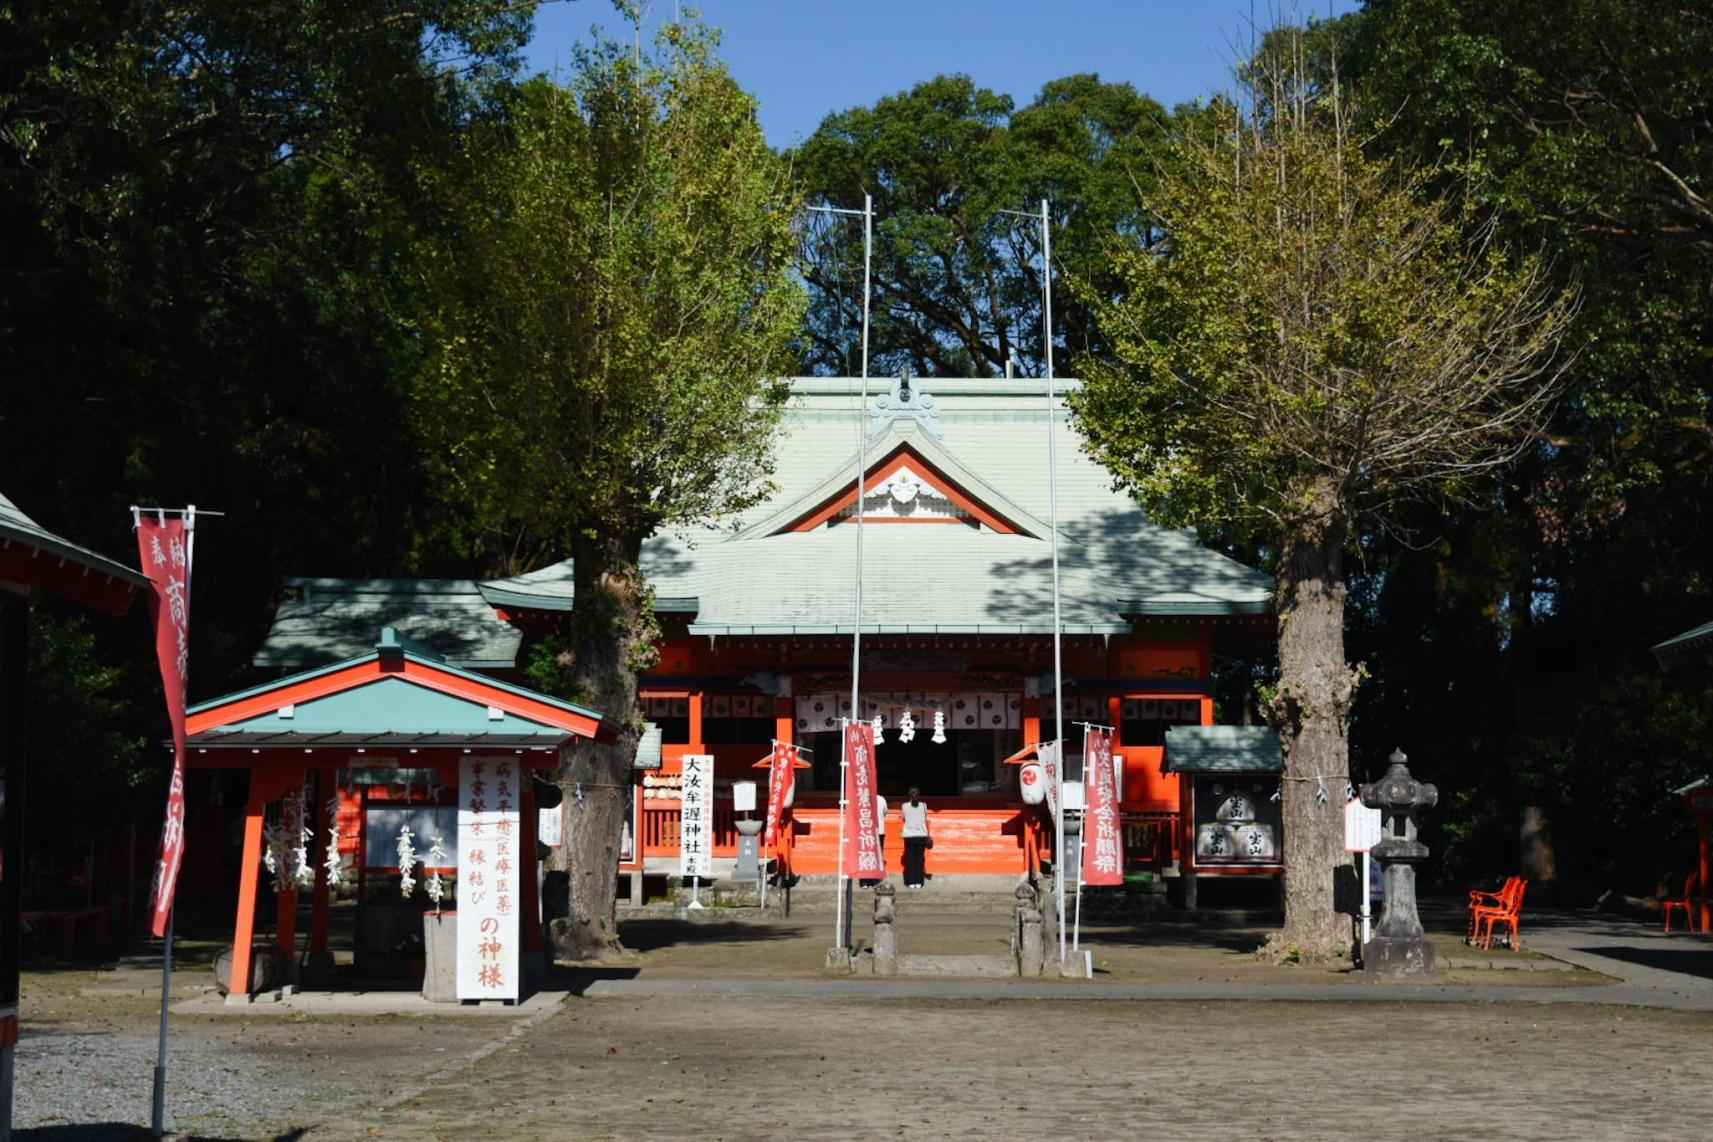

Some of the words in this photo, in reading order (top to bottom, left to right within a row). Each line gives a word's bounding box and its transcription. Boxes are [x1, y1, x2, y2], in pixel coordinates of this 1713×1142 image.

[469, 848, 487, 905] 縁結び
[478, 916, 504, 989] の神様
